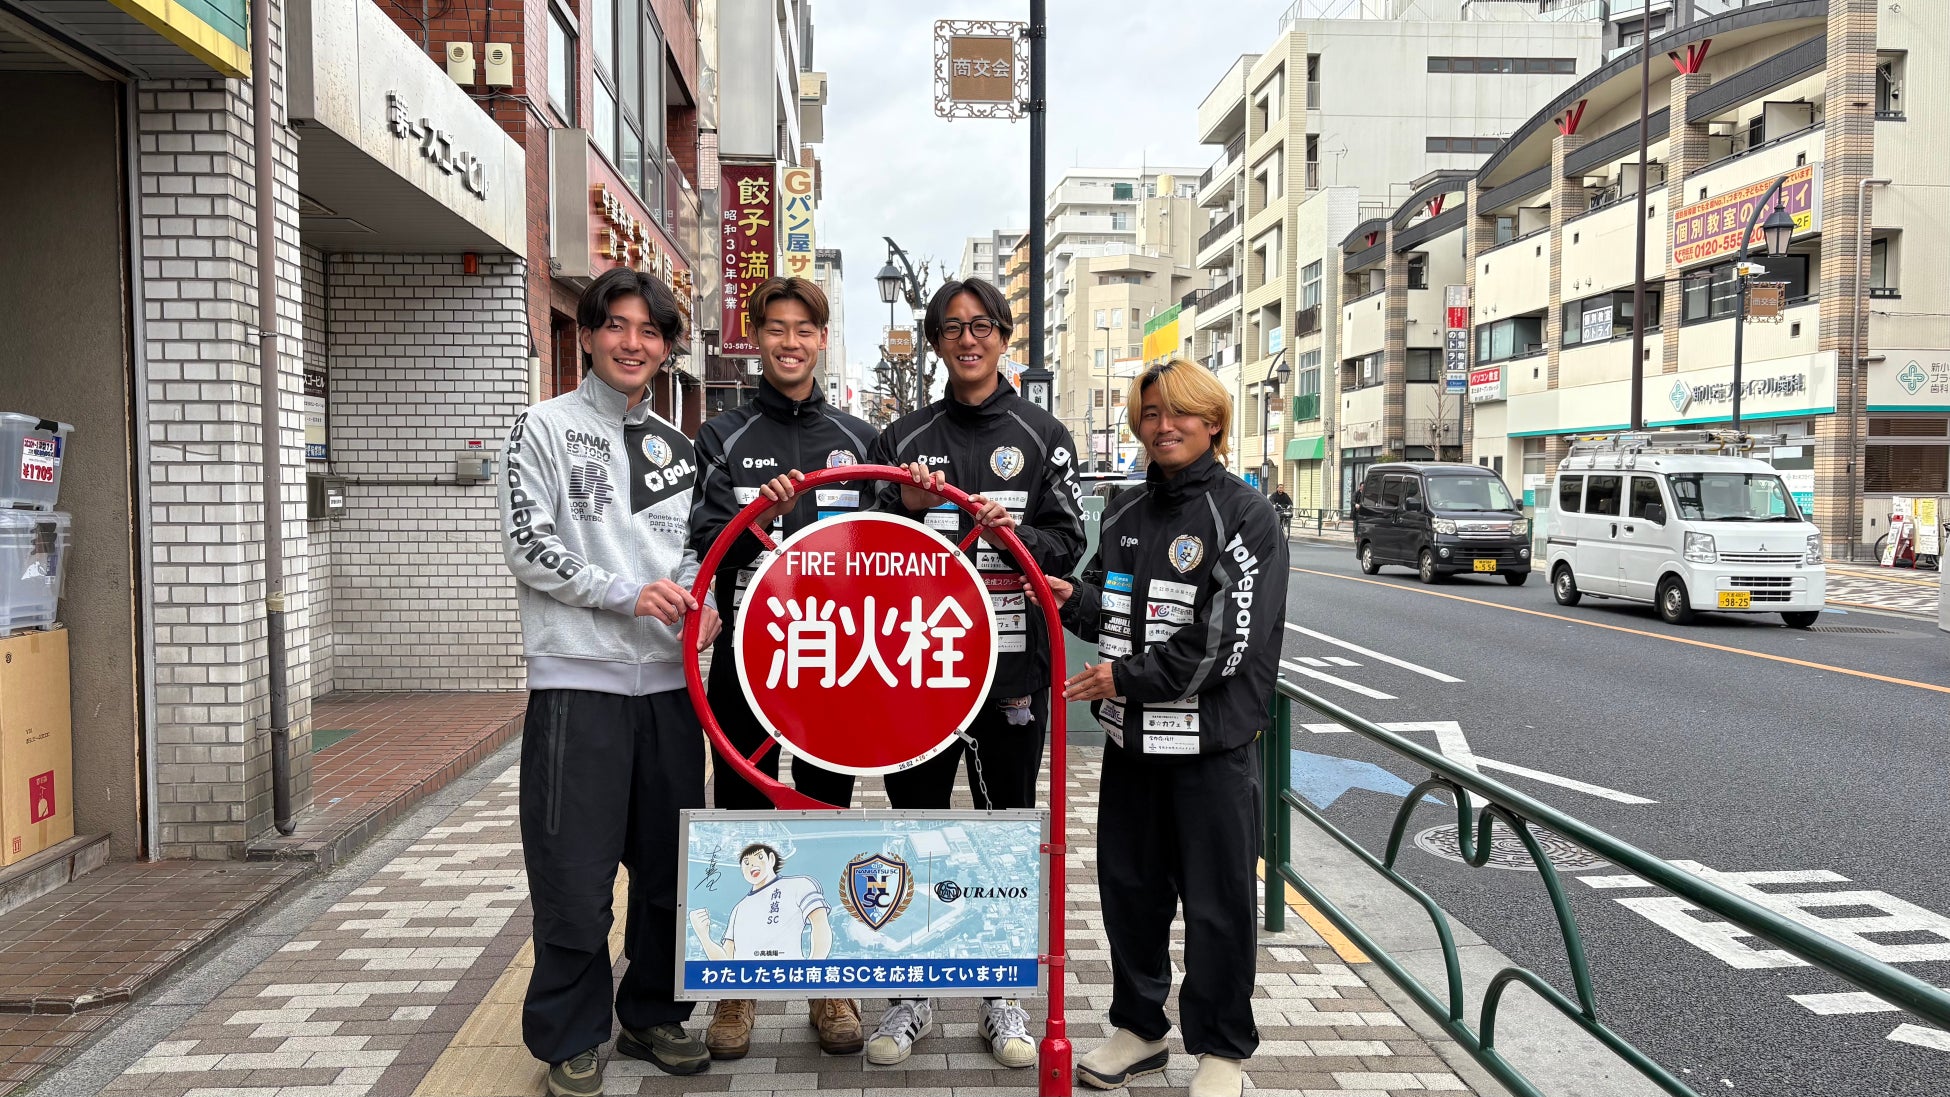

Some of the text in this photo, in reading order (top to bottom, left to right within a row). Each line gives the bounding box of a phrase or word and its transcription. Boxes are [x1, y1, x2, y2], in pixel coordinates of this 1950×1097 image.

[953, 57, 1010, 78] 商交会
[784, 170, 812, 280] Gパン屋サ
[565, 429, 611, 453] GANAR
[566, 442, 611, 462] ES TODO
[929, 455, 950, 466] gol.
[23, 463, 52, 481] ¥1705
[663, 458, 696, 486] gol.
[755, 457, 778, 468] gol.
[786, 551, 836, 576] FIRE
[846, 552, 951, 577] HYDRANT
[1725, 598, 1749, 607] 98-25
[766, 595, 974, 690] 消火栓
[963, 886, 1028, 899] URANOS
[701, 965, 1018, 984] わたしたちは南葛SCを応援しています!!
